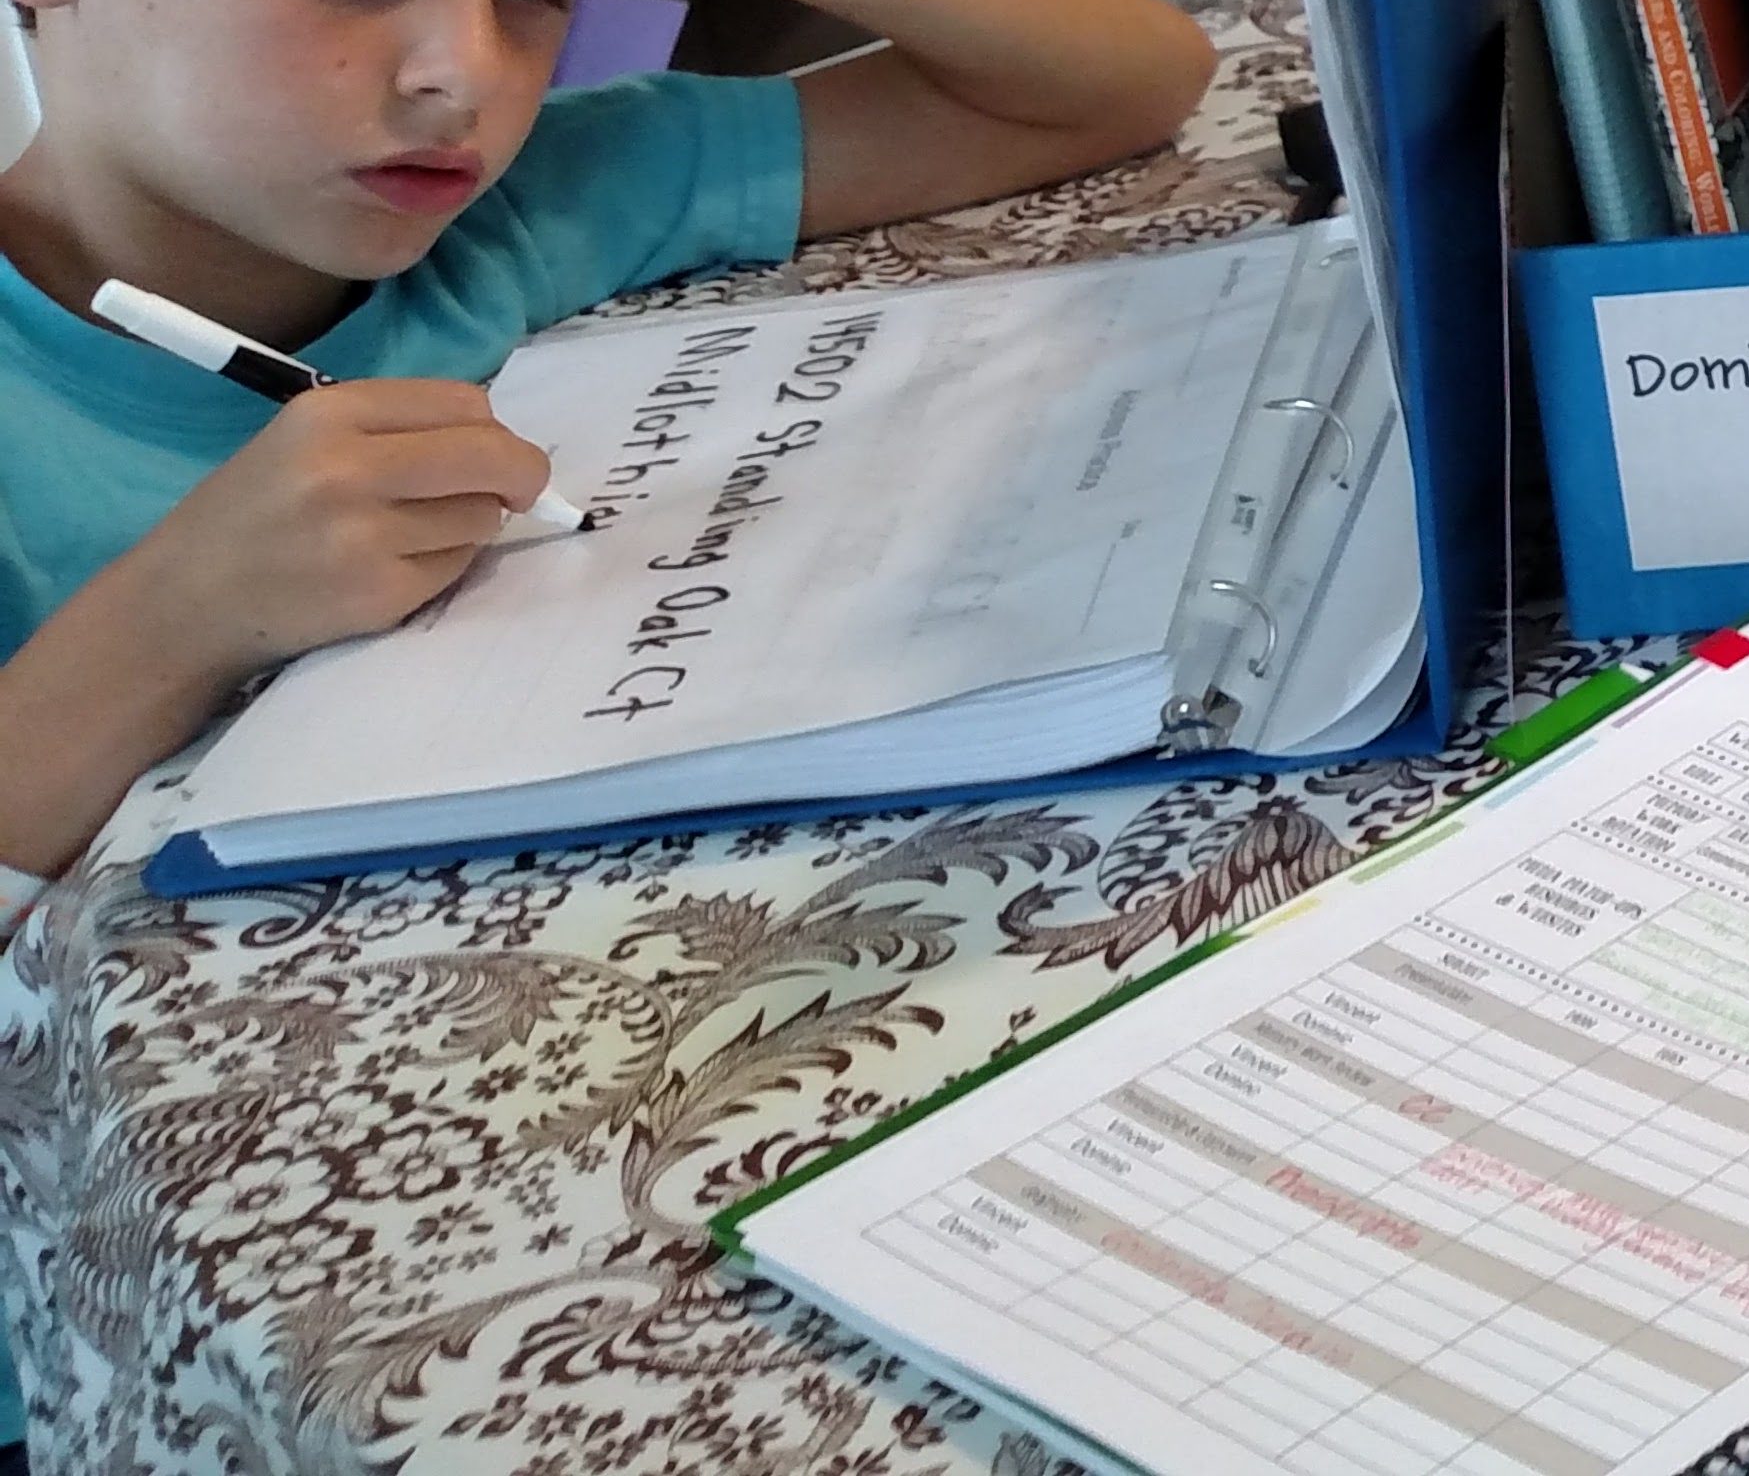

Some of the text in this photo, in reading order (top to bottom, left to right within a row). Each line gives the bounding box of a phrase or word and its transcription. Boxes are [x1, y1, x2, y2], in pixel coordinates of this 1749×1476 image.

[583, 309, 885, 723] 14502 Standing Oak Ct
